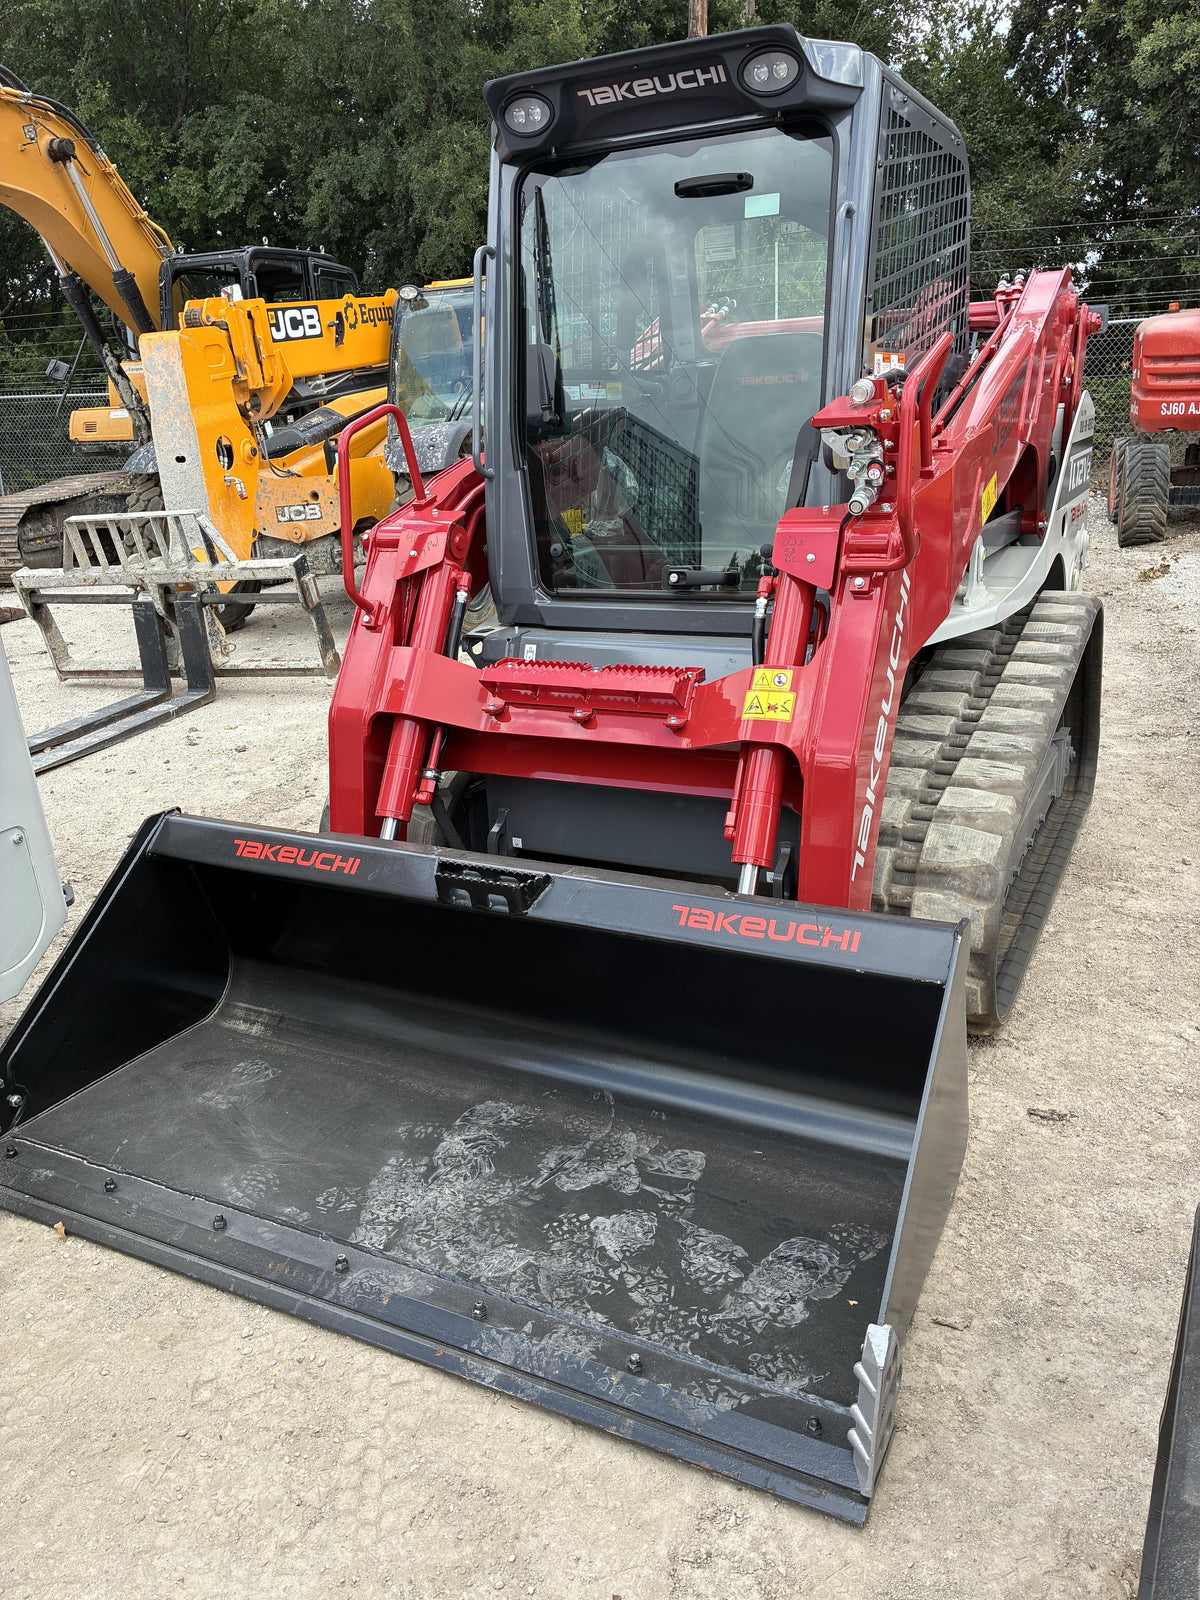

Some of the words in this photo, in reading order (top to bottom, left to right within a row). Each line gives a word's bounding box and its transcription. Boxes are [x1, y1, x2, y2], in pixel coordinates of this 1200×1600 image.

[577, 64, 727, 106] TAKEUCHI
[270, 308, 322, 340] JCB
[1161, 402, 1185, 415] SJ60
[277, 504, 321, 522] JCB
[233, 839, 361, 875] TAKEUCHI
[672, 905, 861, 953] TAKEUCHI
